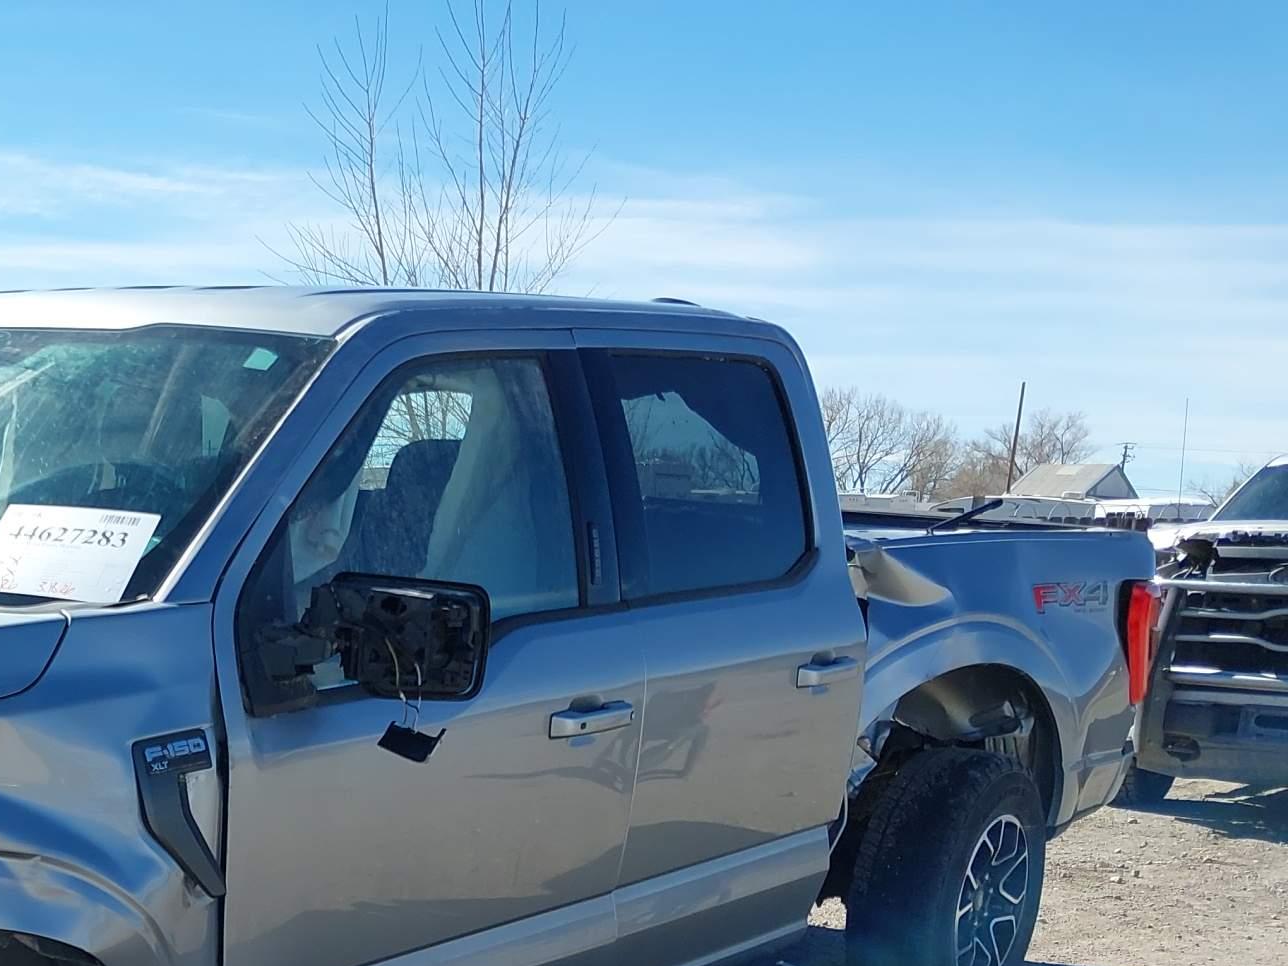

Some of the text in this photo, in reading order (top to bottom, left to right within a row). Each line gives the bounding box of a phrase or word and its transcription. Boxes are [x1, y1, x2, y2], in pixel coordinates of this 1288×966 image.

[8, 524, 129, 549] 44627283
[1032, 581, 1108, 615] FX4
[144, 737, 206, 762] F-150
[150, 760, 169, 772] XLT
